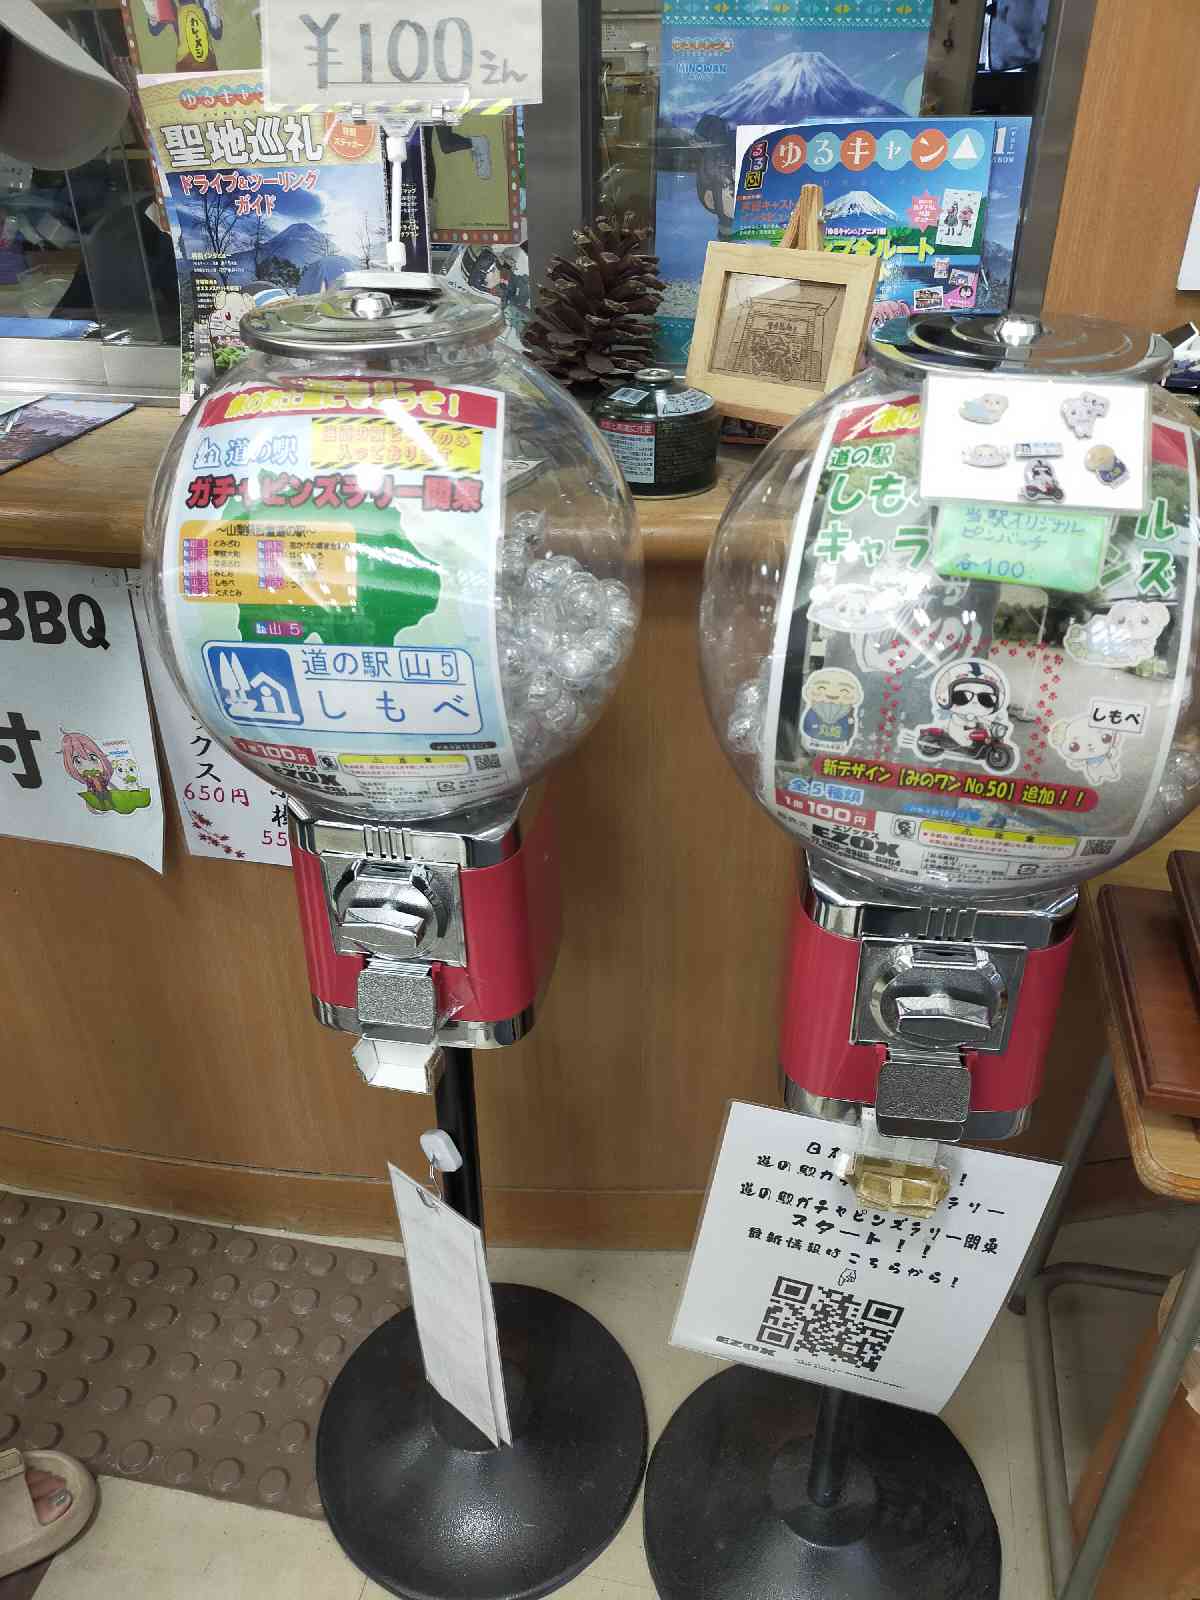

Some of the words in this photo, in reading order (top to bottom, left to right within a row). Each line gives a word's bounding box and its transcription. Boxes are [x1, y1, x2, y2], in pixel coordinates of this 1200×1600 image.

[181, 86, 264, 107] ゆるキャ
[160, 113, 324, 167] 聖地巡礼
[745, 140, 768, 190] るるぶ
[234, 193, 277, 217] ガイド
[226, 433, 299, 466] 道の駅
[830, 443, 894, 470] 道の駅
[1135, 497, 1178, 541] ル
[815, 522, 932, 570] キャラ
[302, 649, 393, 678] 道の駅
[317, 689, 470, 723] しもべ
[1092, 707, 1141, 726] しもべ
[821, 757, 892, 783] 新デザイン
[183, 782, 251, 808] 650円
[812, 823, 900, 859] EZOX
[947, 1196, 1006, 1215] ラリー
[715, 1335, 777, 1357] EZOX
